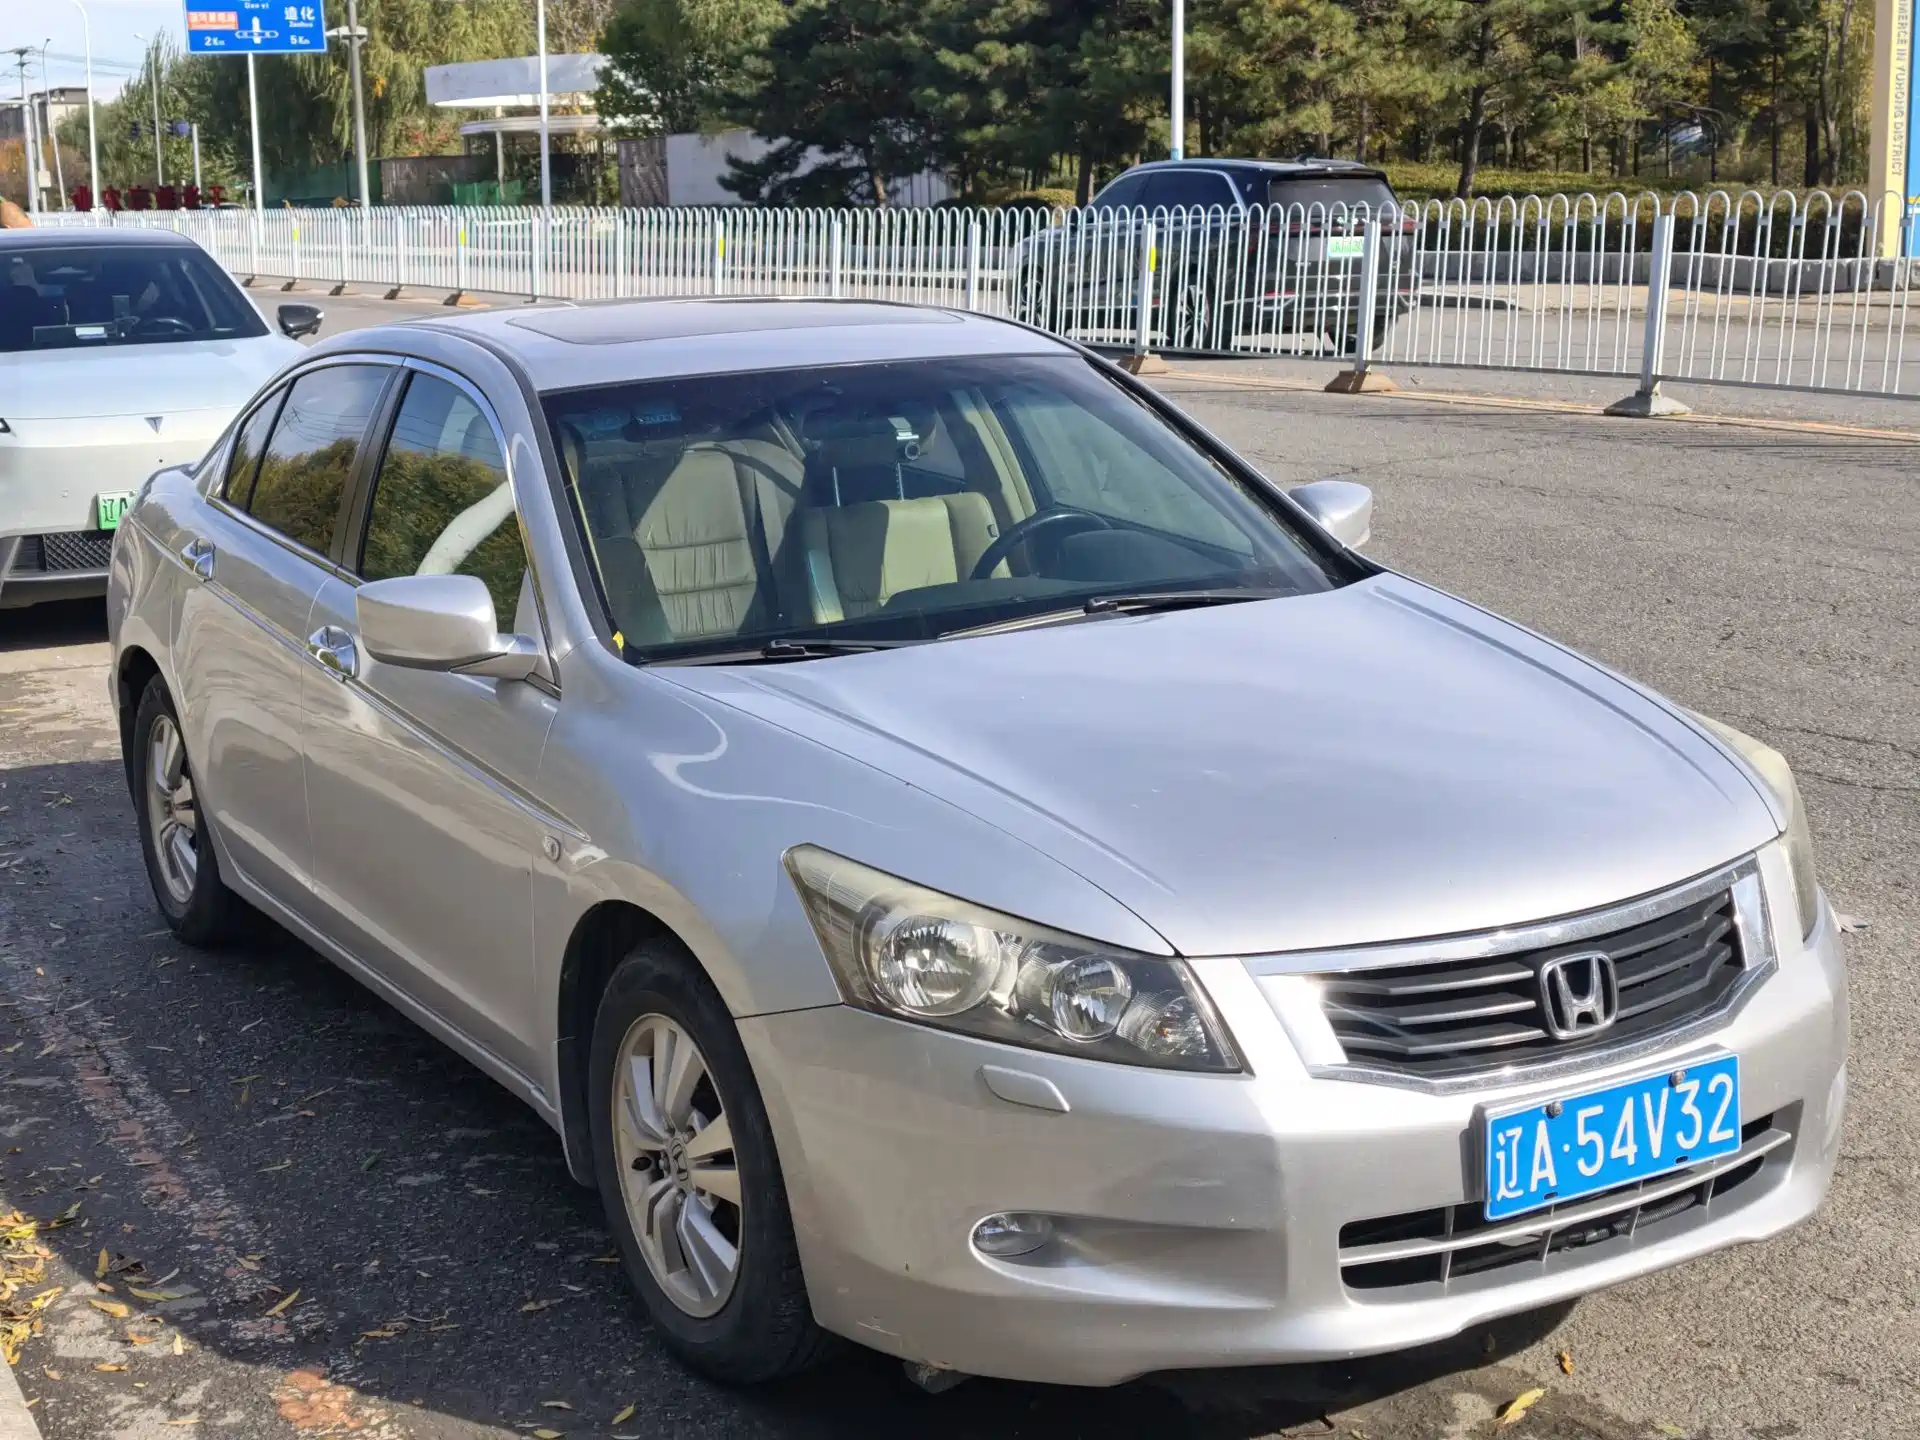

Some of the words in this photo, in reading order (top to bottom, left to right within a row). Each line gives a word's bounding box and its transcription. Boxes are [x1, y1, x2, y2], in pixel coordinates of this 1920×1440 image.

[1897, 0, 1909, 44] MERCE
[1896, 48, 1907, 61] IN
[1894, 65, 1906, 118] YUHONG
[1892, 121, 1904, 176] DISTRICT
[1496, 1072, 1735, 1201] 辽A·54V32
